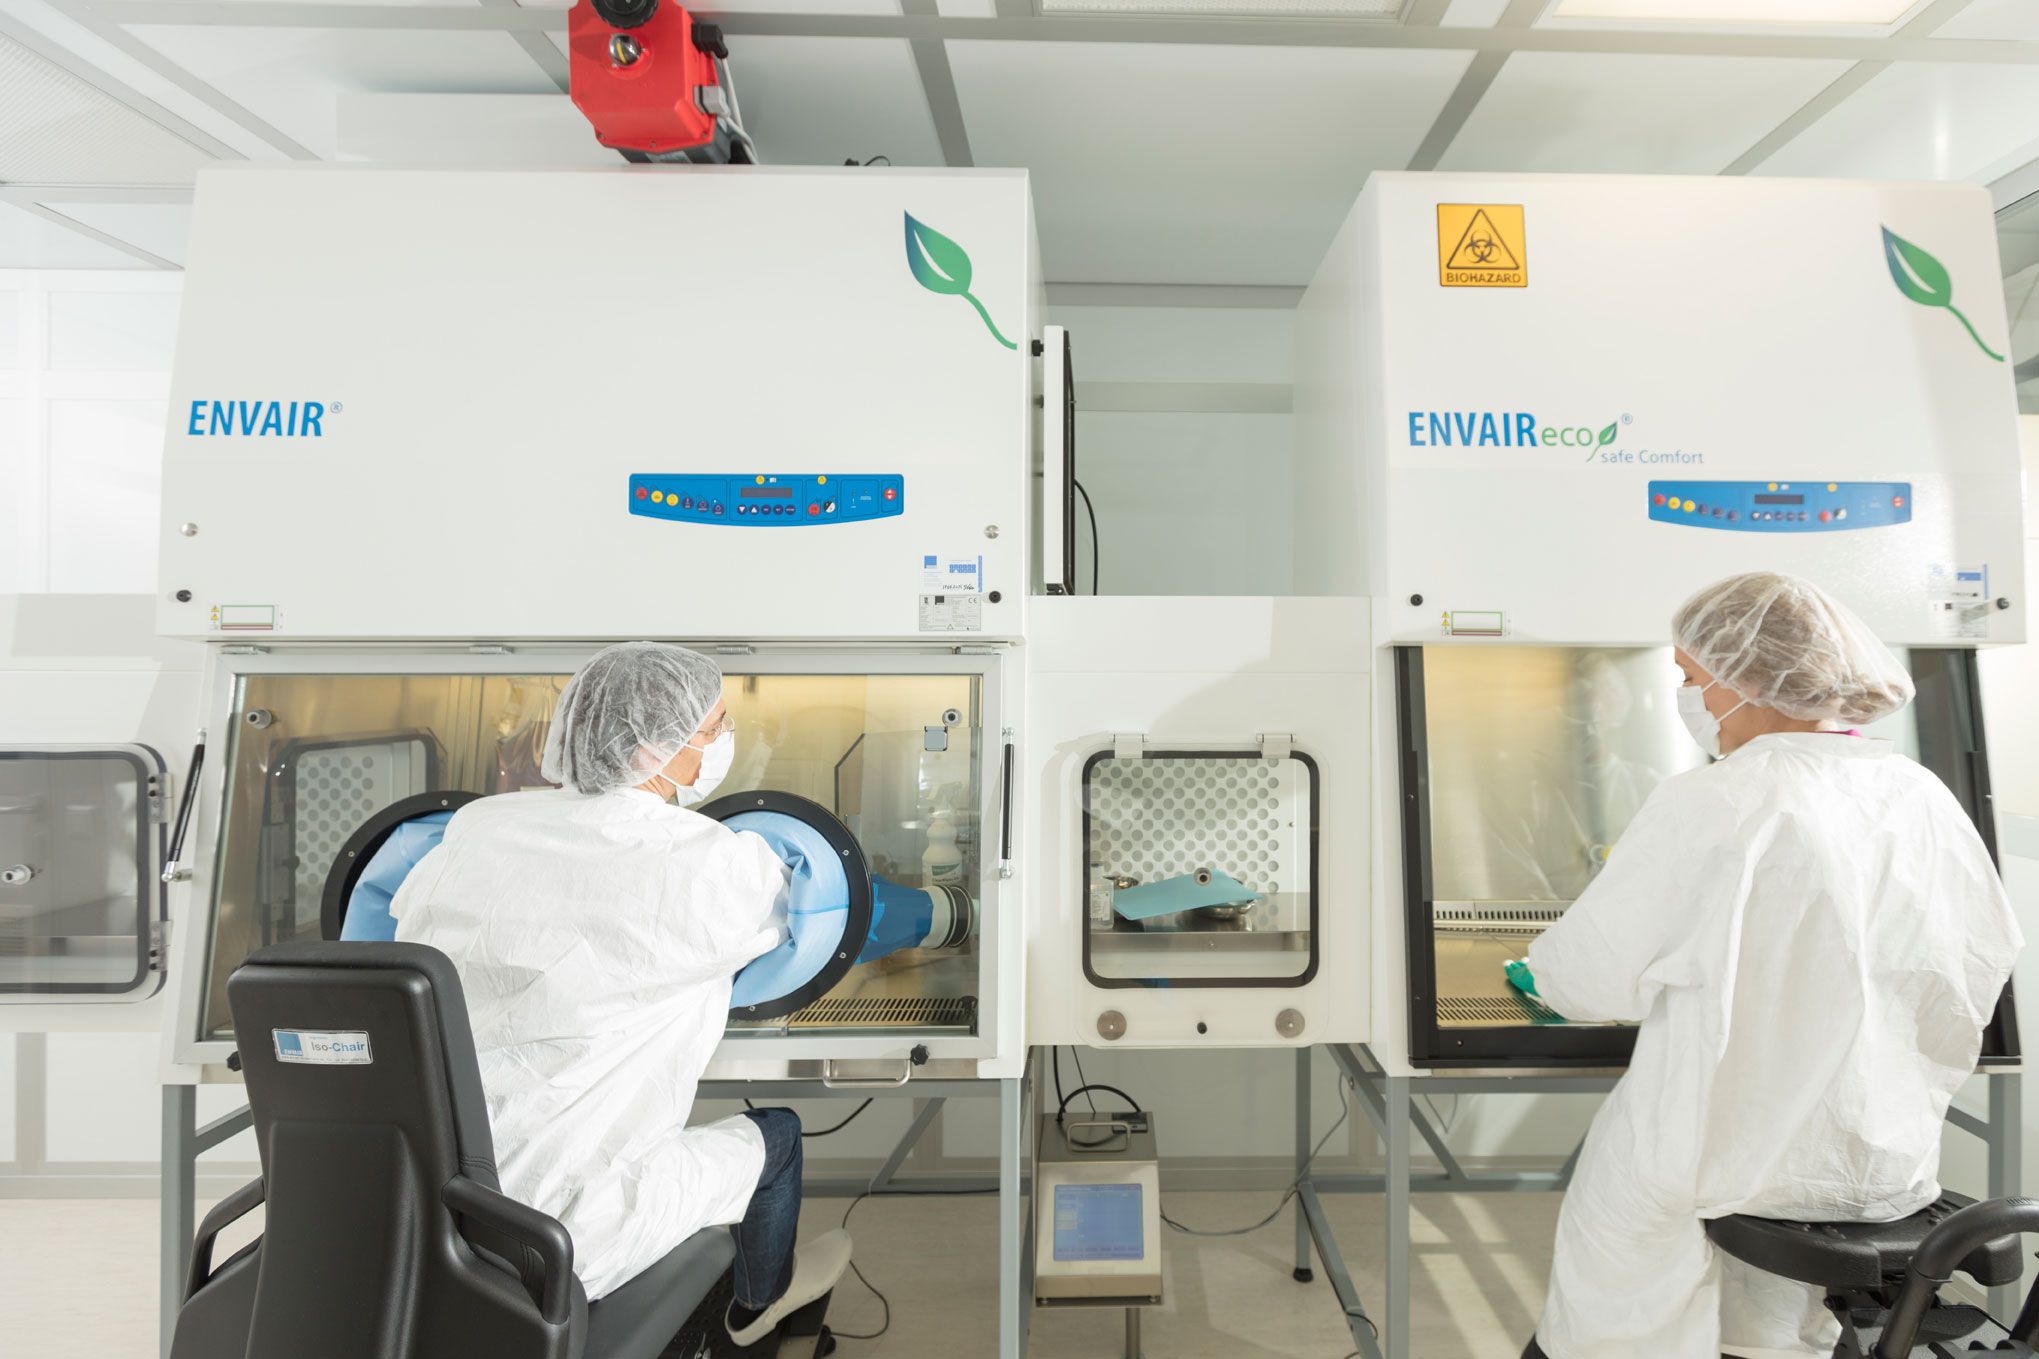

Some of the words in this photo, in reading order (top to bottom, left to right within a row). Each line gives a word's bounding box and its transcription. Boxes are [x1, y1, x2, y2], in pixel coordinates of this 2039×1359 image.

[1446, 272, 1521, 283] BIOHAZARD
[1601, 449, 1634, 463] safe
[1639, 449, 1704, 464] Comfort
[311, 1041, 365, 1052] Iso-Chair
